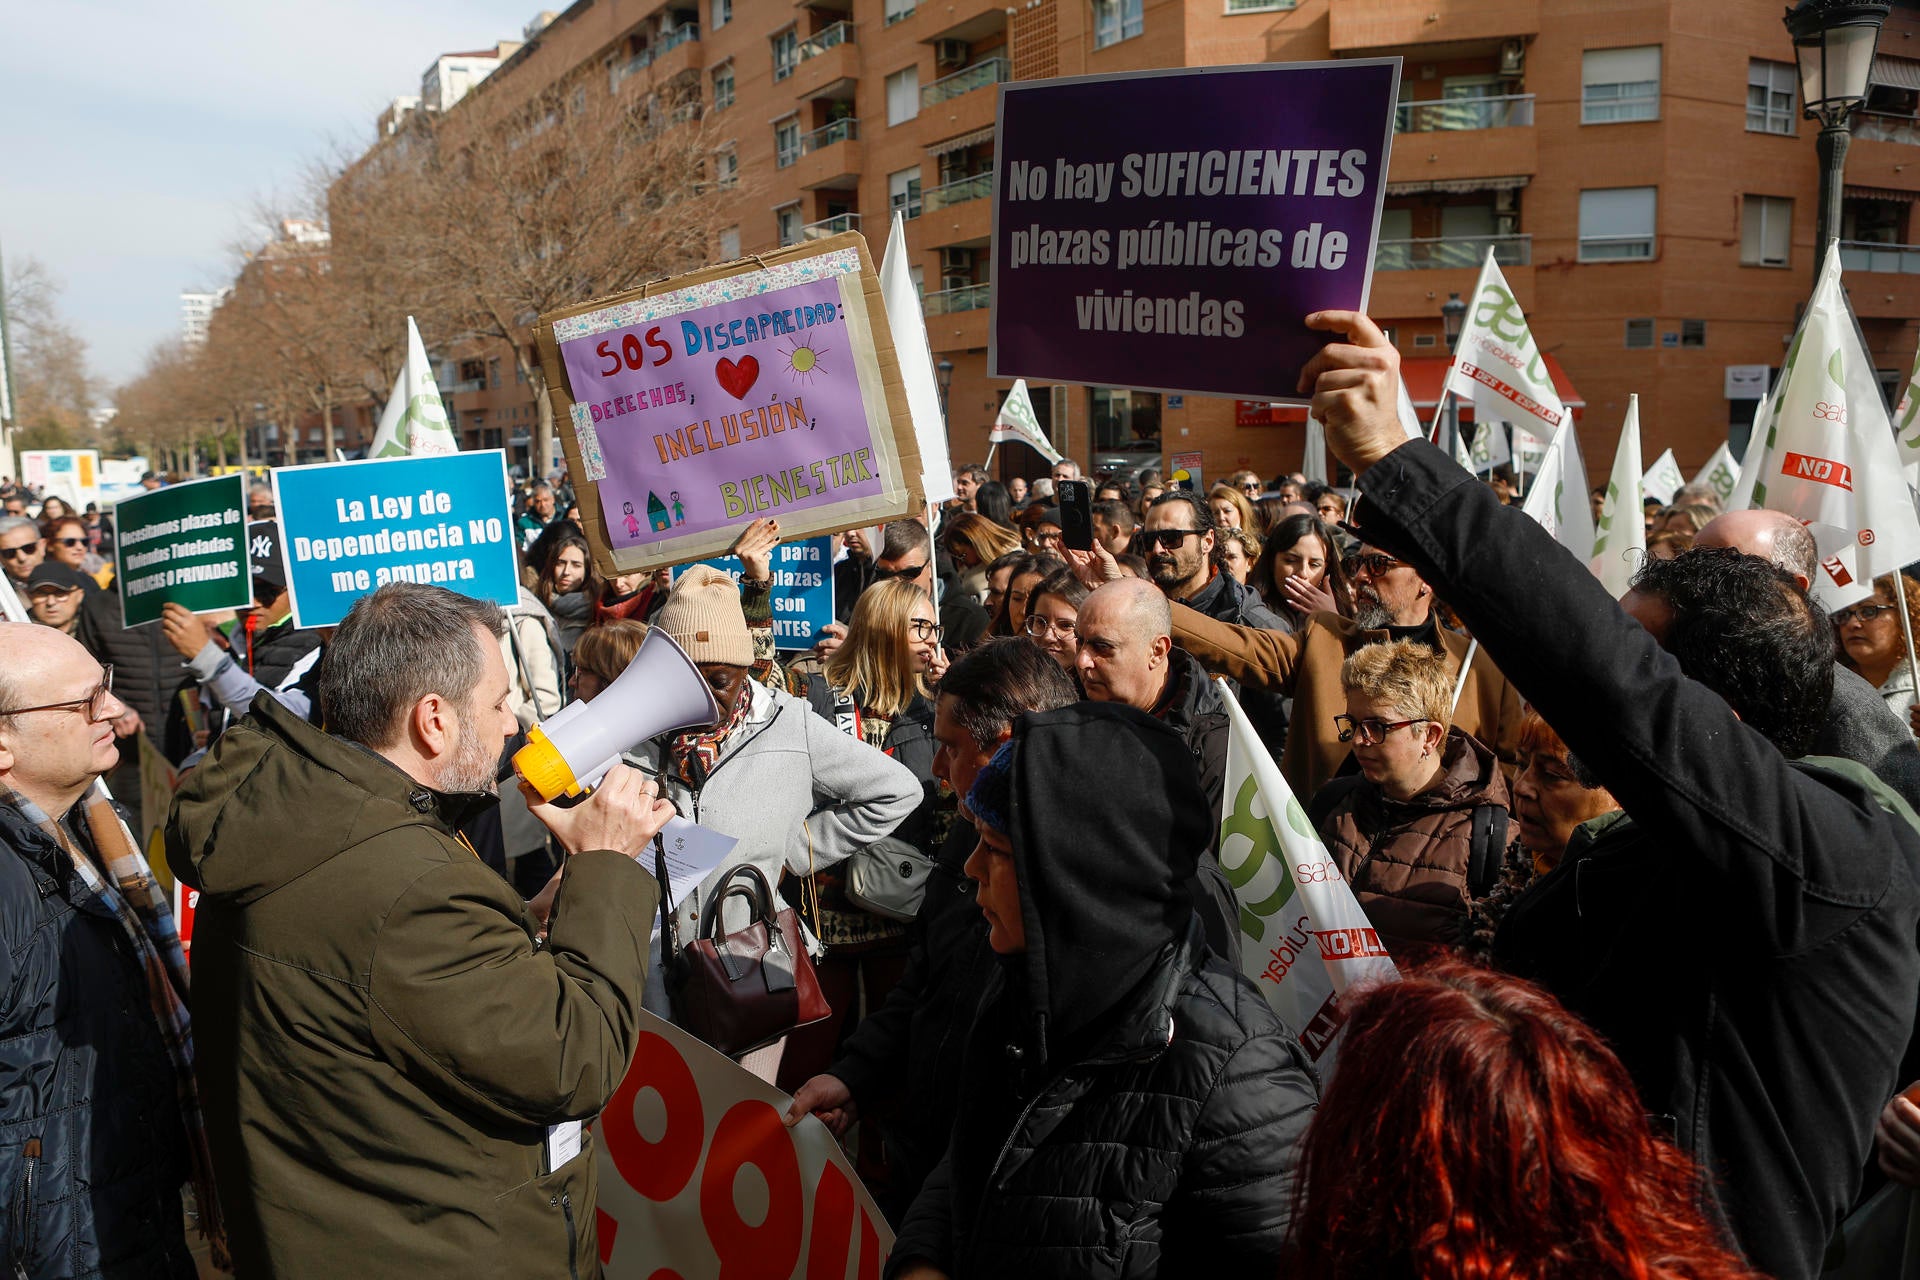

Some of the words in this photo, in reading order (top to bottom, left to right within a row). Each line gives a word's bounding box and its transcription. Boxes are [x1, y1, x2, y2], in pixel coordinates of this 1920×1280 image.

[1009, 160, 1047, 201] No
[1055, 158, 1114, 202] hay
[1121, 149, 1367, 198] SUFICIENTES
[1011, 224, 1110, 269] plazas
[1118, 220, 1282, 269] públicas
[1291, 222, 1349, 270] de
[1076, 289, 1245, 337] viviendas
[597, 326, 673, 377] SOS
[1499, 384, 1514, 398] LA
[1798, 458, 1833, 479] NO
[336, 498, 365, 523] La
[370, 495, 412, 520] Ley
[419, 490, 451, 515] de
[120, 519, 180, 547] Necesitamos
[180, 511, 222, 533] plazas
[223, 508, 241, 524] de
[294, 523, 463, 561] Dependencia
[469, 518, 502, 544] NO
[170, 537, 234, 559] Tuteladas
[781, 546, 820, 561] para
[166, 570, 175, 586] O
[175, 561, 238, 584] PRIVADAS
[331, 569, 370, 592] me
[376, 559, 474, 588] ampara
[775, 598, 806, 613] son
[1314, 932, 1351, 955] NO
